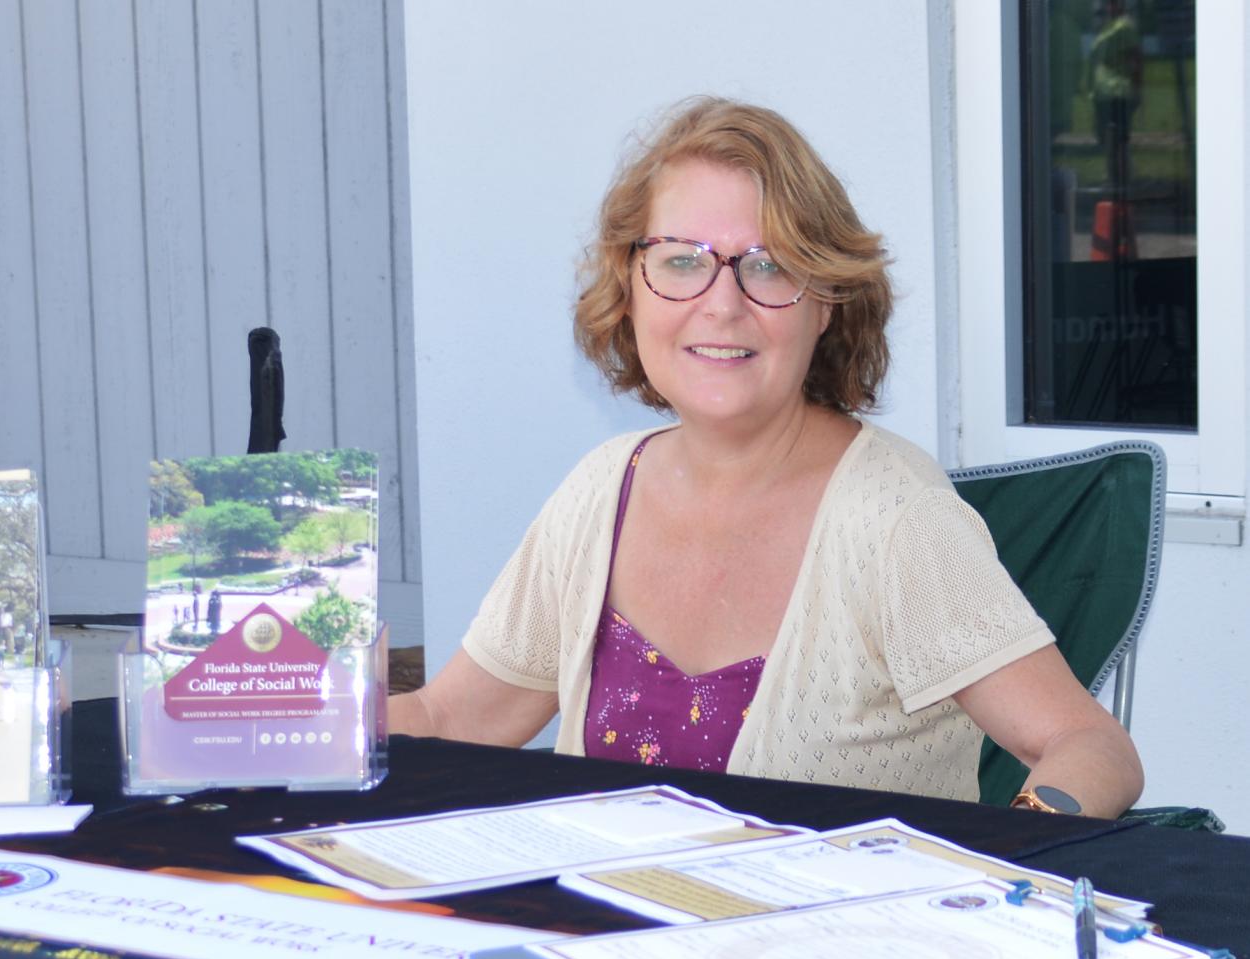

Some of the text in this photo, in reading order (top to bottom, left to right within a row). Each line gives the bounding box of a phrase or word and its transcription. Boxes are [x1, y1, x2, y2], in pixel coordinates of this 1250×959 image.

[204, 662, 322, 676] Florida State University
[188, 679, 239, 695] College
[240, 678, 255, 691] of
[257, 677, 296, 691] Social
